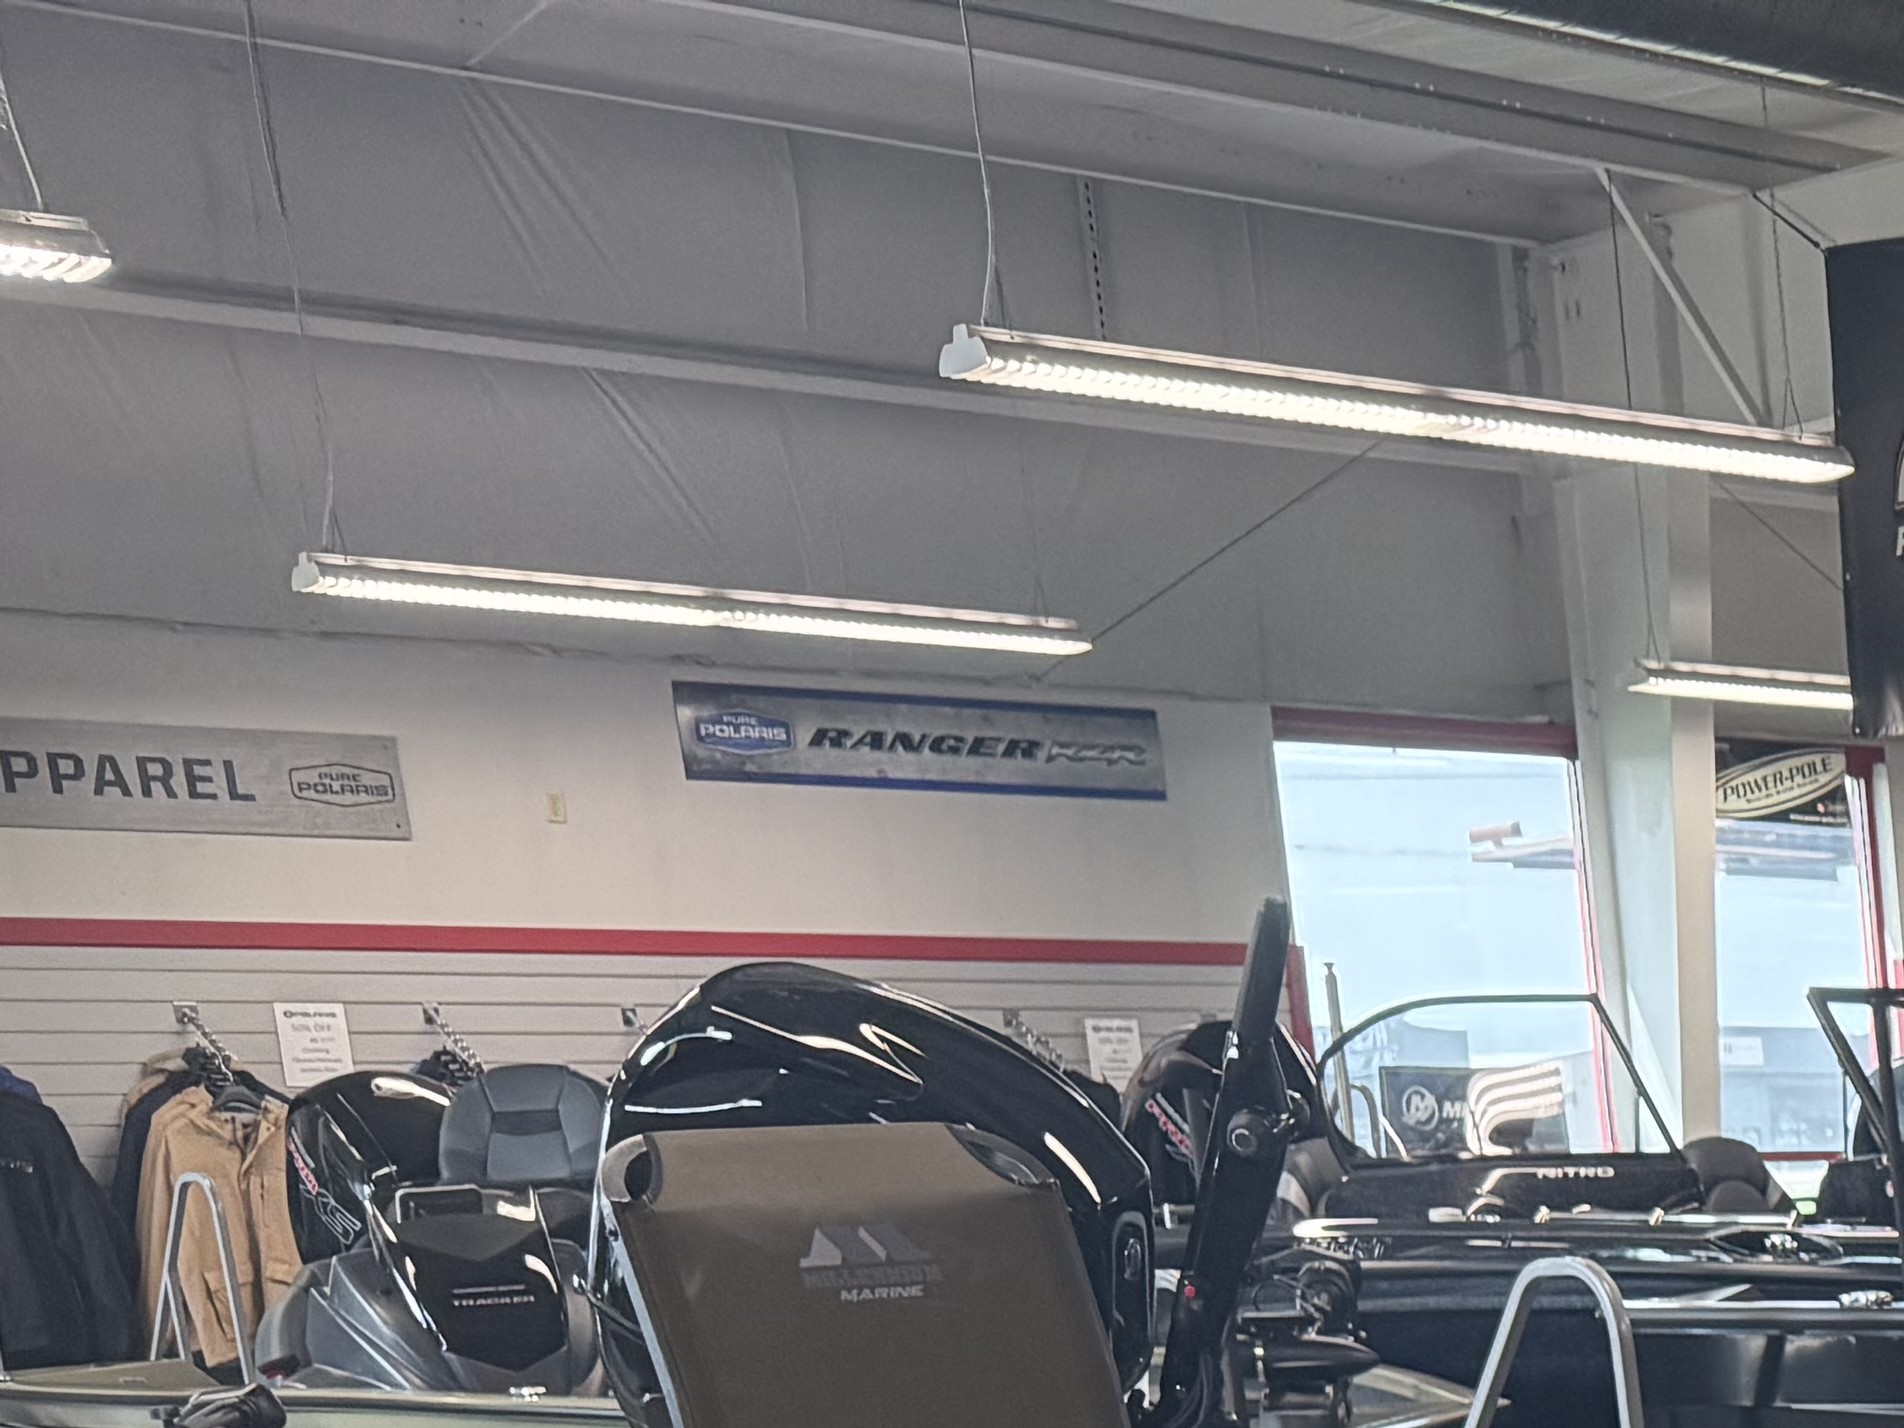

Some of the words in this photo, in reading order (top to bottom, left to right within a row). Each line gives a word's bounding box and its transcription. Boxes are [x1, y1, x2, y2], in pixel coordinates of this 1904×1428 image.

[808, 726, 1042, 759] RANGER
[296, 781, 391, 798] POLARIS
[1722, 754, 1834, 804] POWER-POLE
[840, 1283, 925, 1302] MARINE
